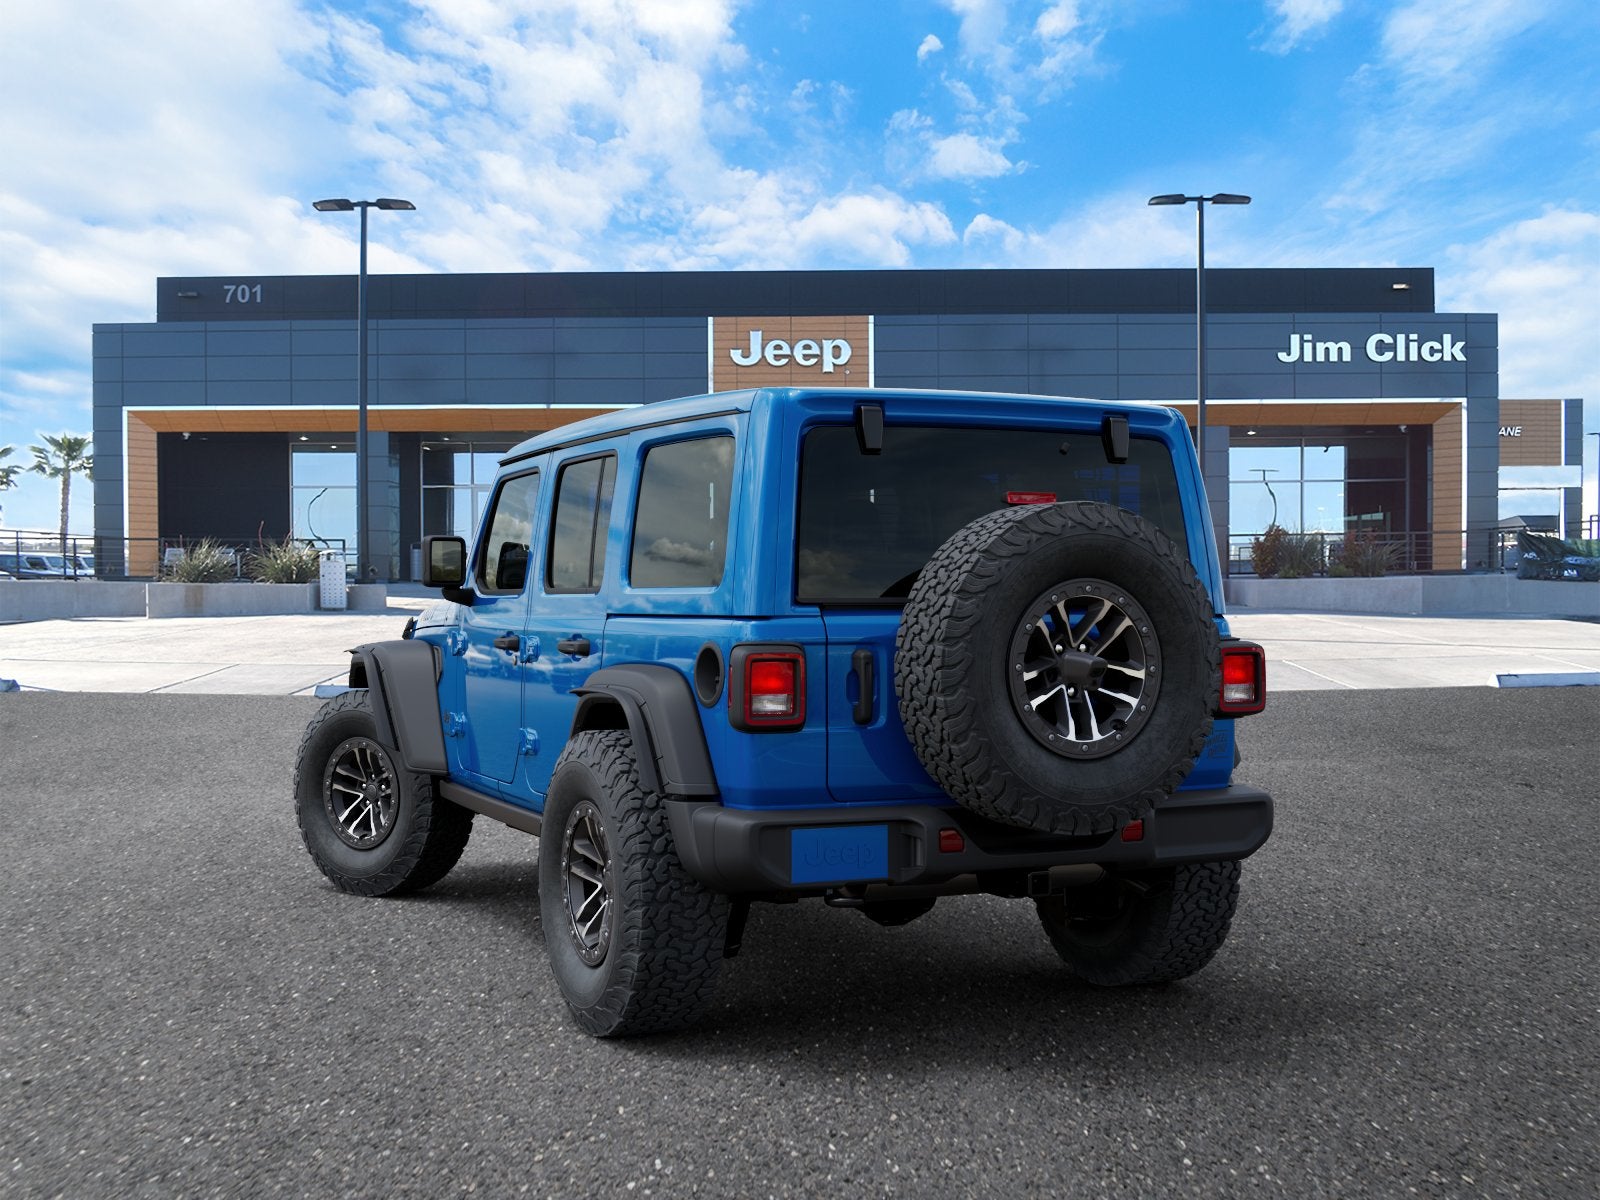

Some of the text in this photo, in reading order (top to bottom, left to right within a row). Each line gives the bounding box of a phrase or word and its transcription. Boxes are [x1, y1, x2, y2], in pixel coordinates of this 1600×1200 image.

[223, 284, 262, 303] 701
[729, 330, 852, 374] Jeep
[1277, 333, 1467, 363] Jim Click
[802, 838, 877, 869] Jeep
